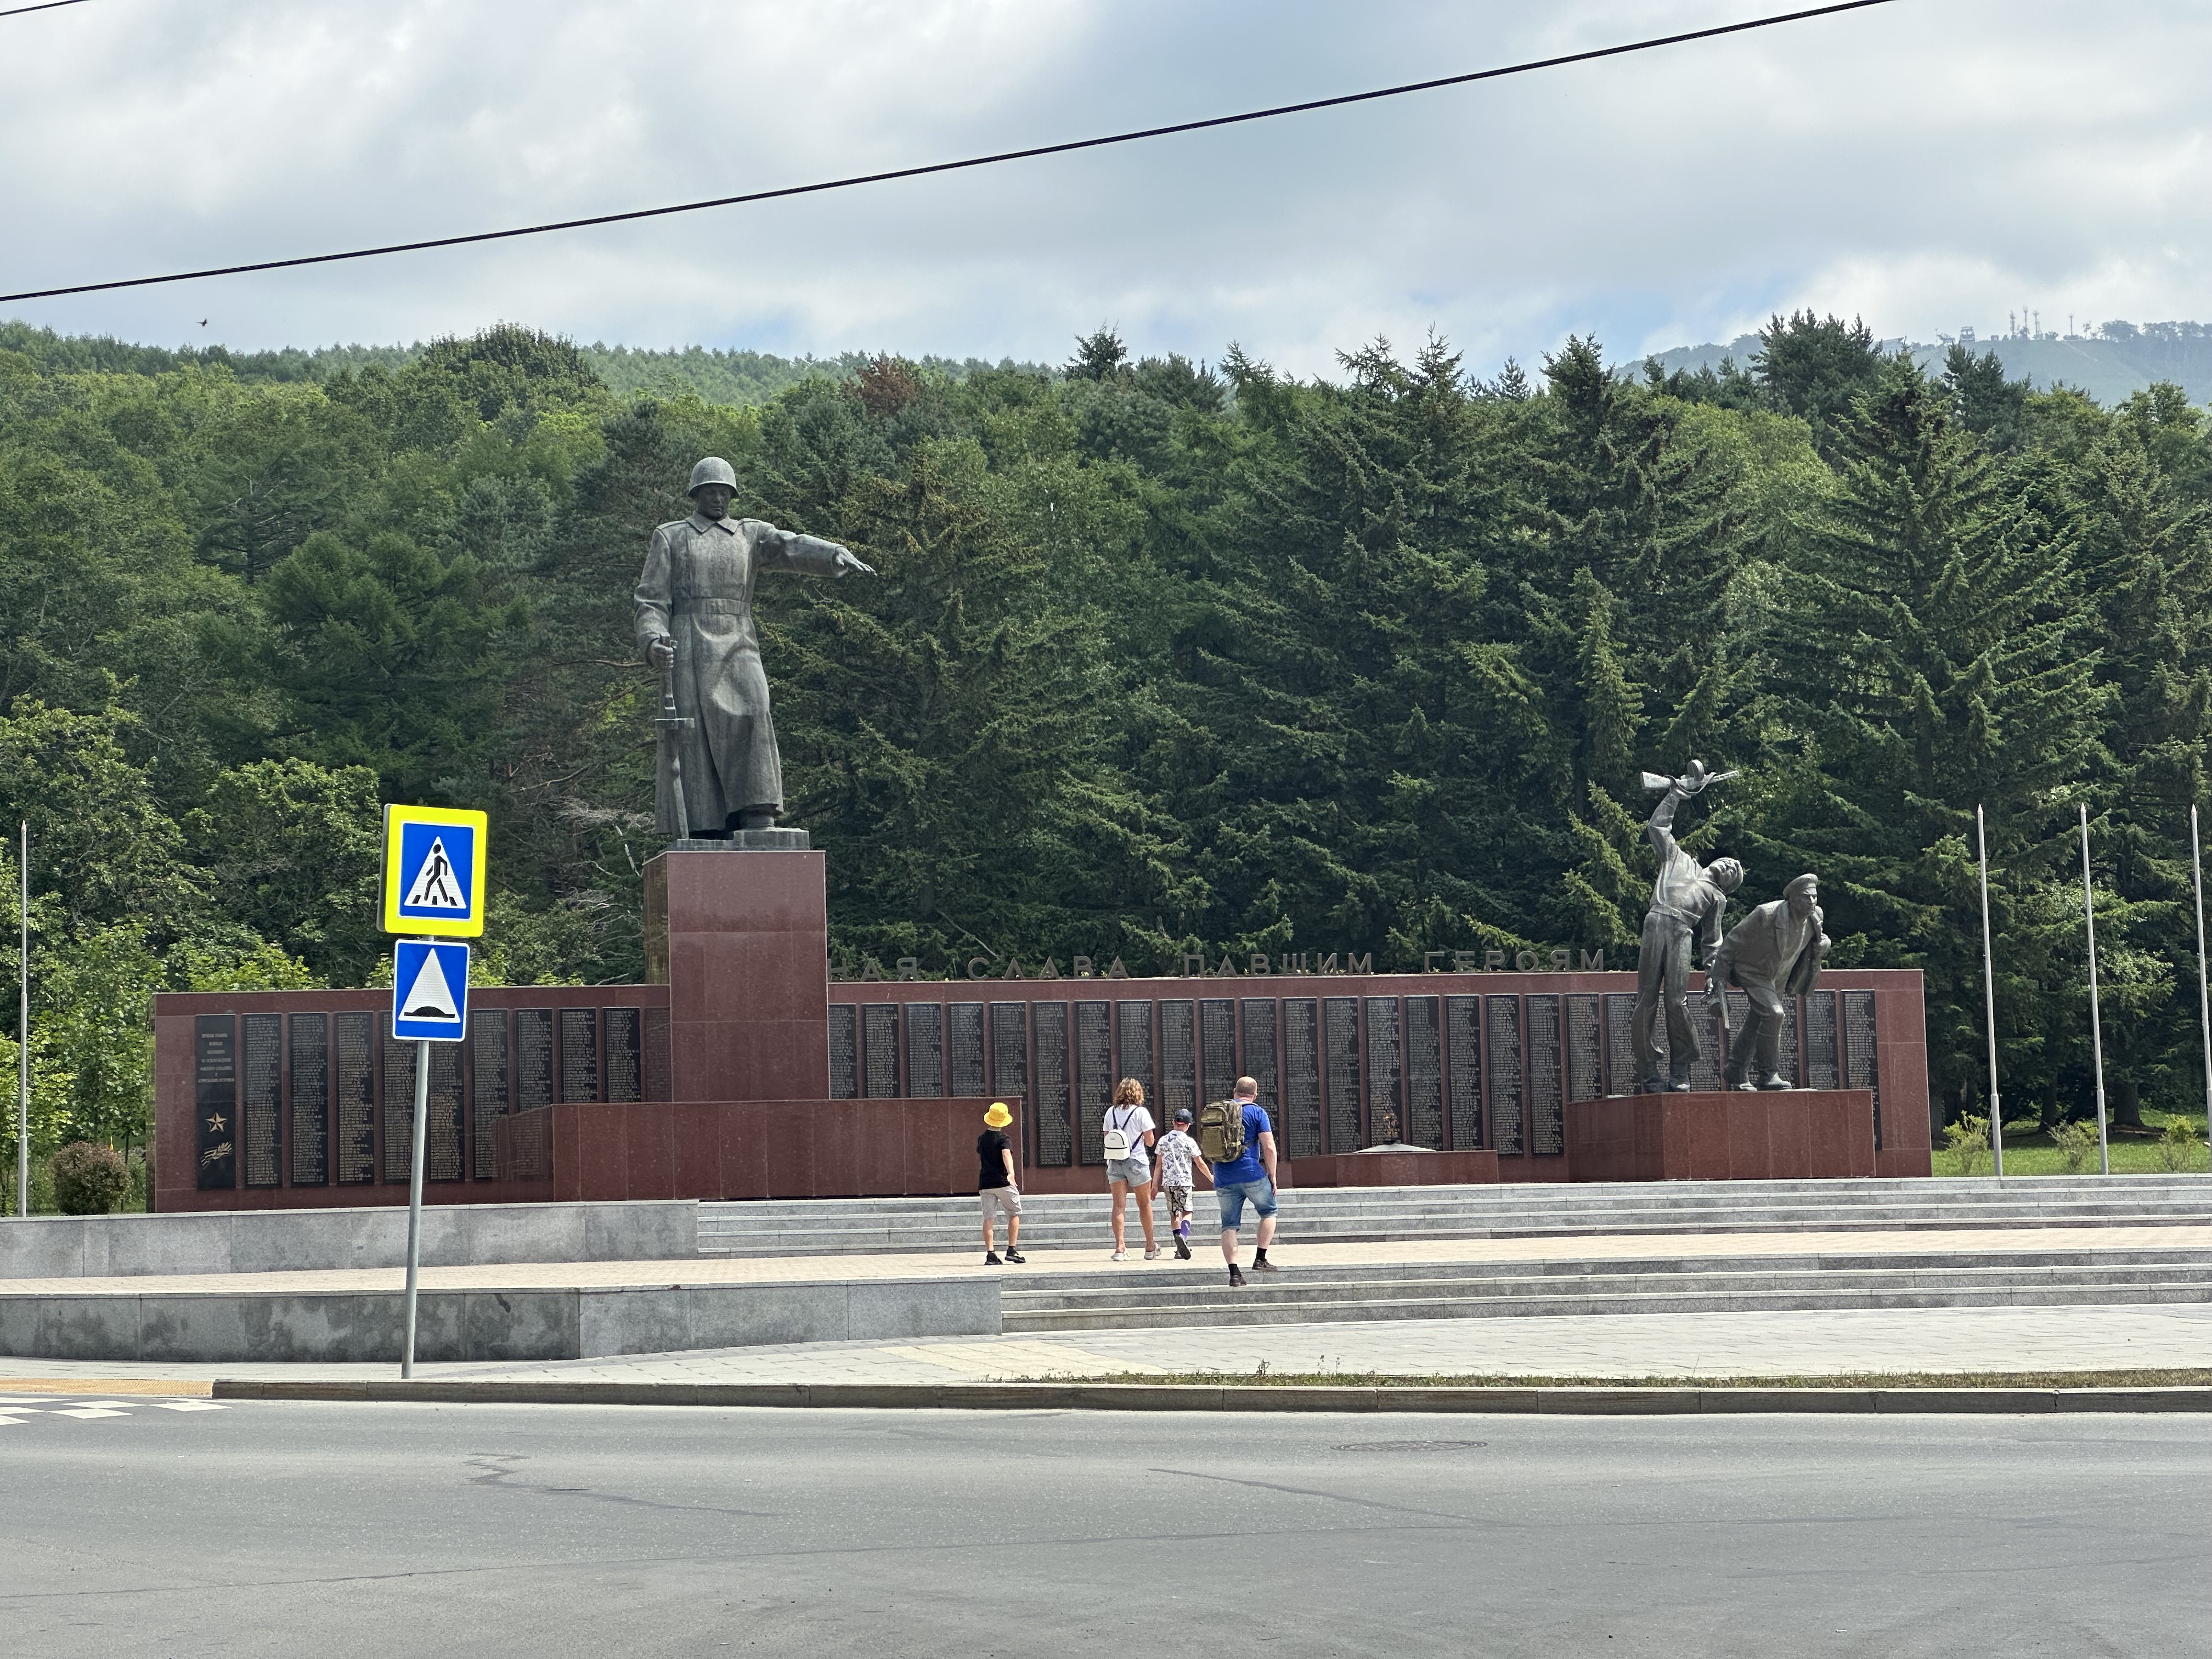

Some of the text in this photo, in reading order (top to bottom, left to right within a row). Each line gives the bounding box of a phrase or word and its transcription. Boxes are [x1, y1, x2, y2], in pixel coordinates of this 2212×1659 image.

[827, 949, 1604, 981] НАЯ СЛАВА ПАВШИМ ГЕРОЯМ
